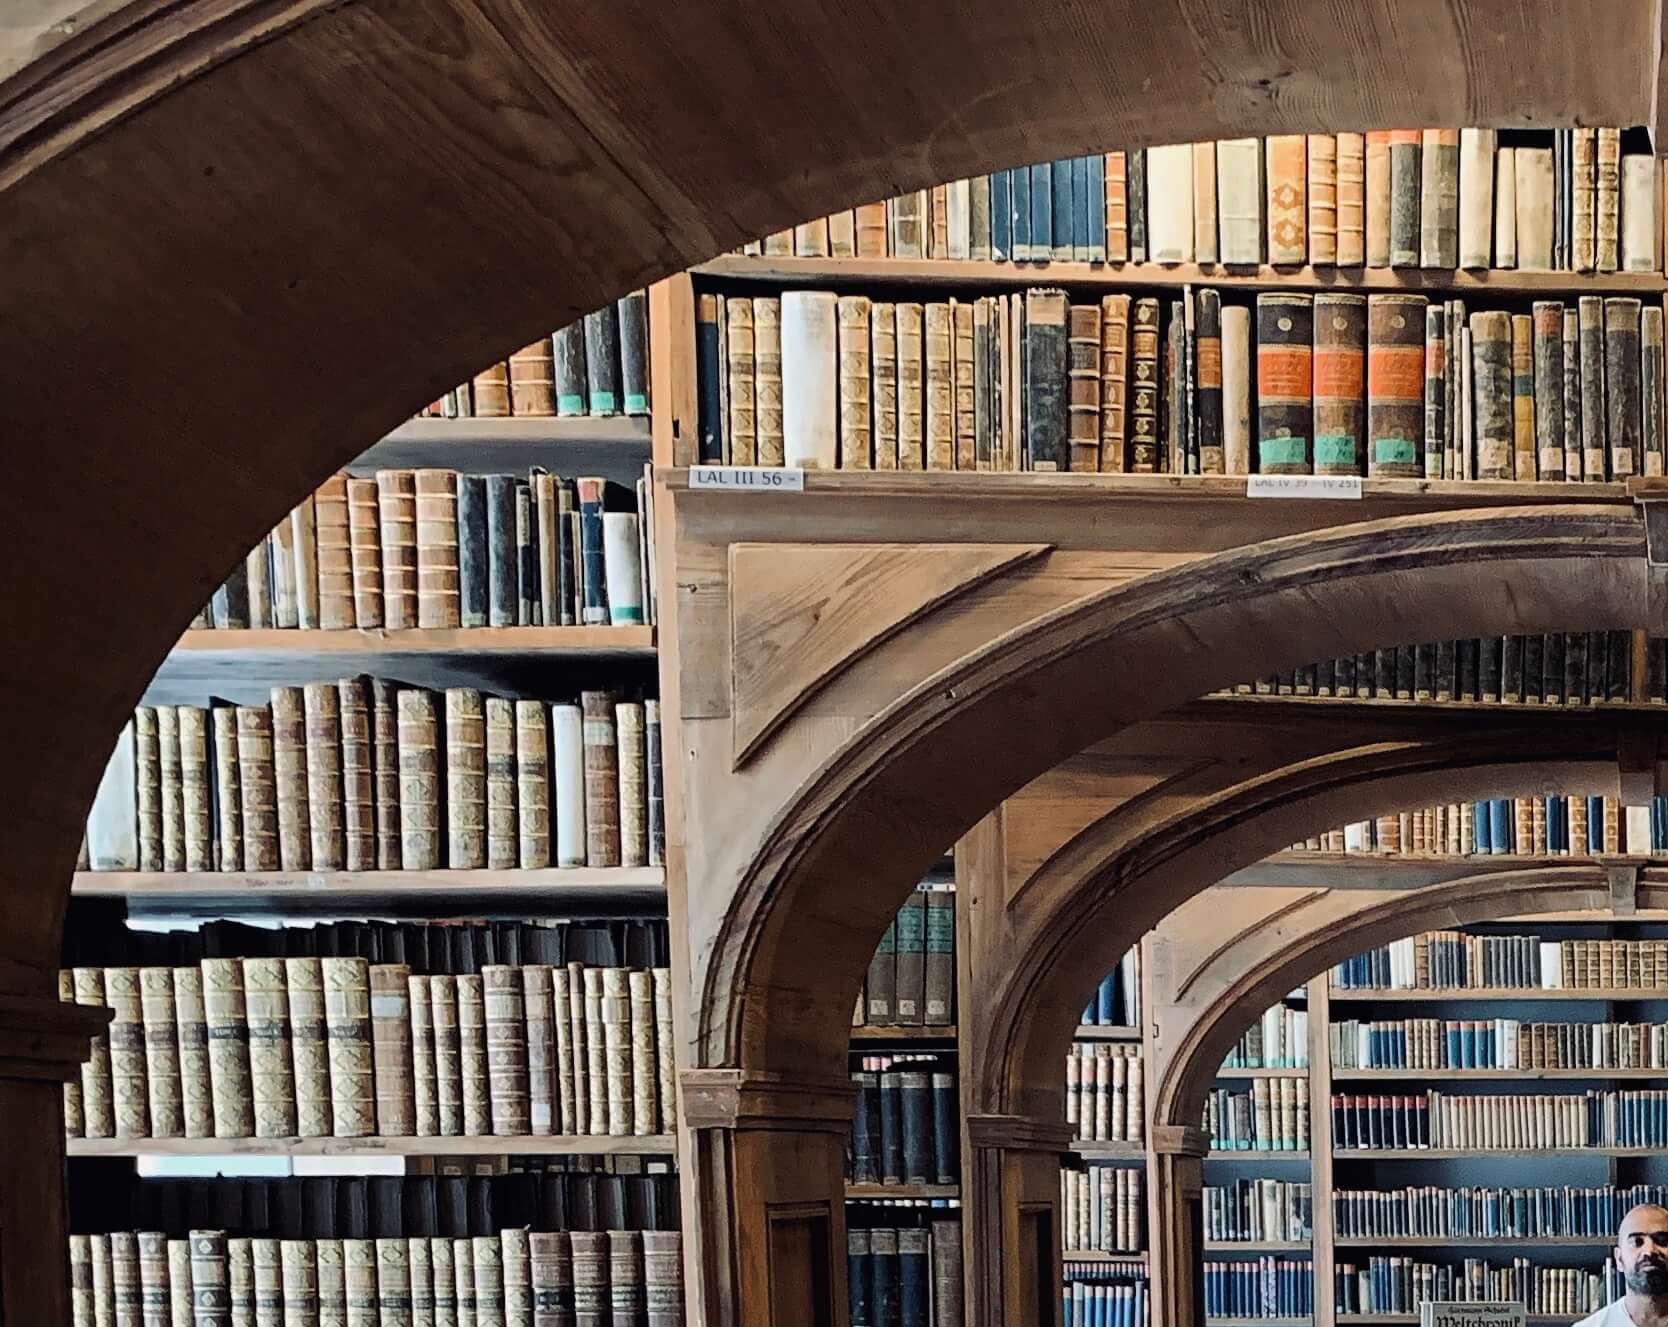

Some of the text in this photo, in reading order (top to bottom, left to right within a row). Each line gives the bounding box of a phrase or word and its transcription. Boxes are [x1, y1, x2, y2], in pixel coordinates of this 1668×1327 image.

[697, 471, 728, 484] LAL
[735, 471, 753, 485] III
[762, 471, 783, 485] 56
[1255, 479, 1275, 487] LAL
